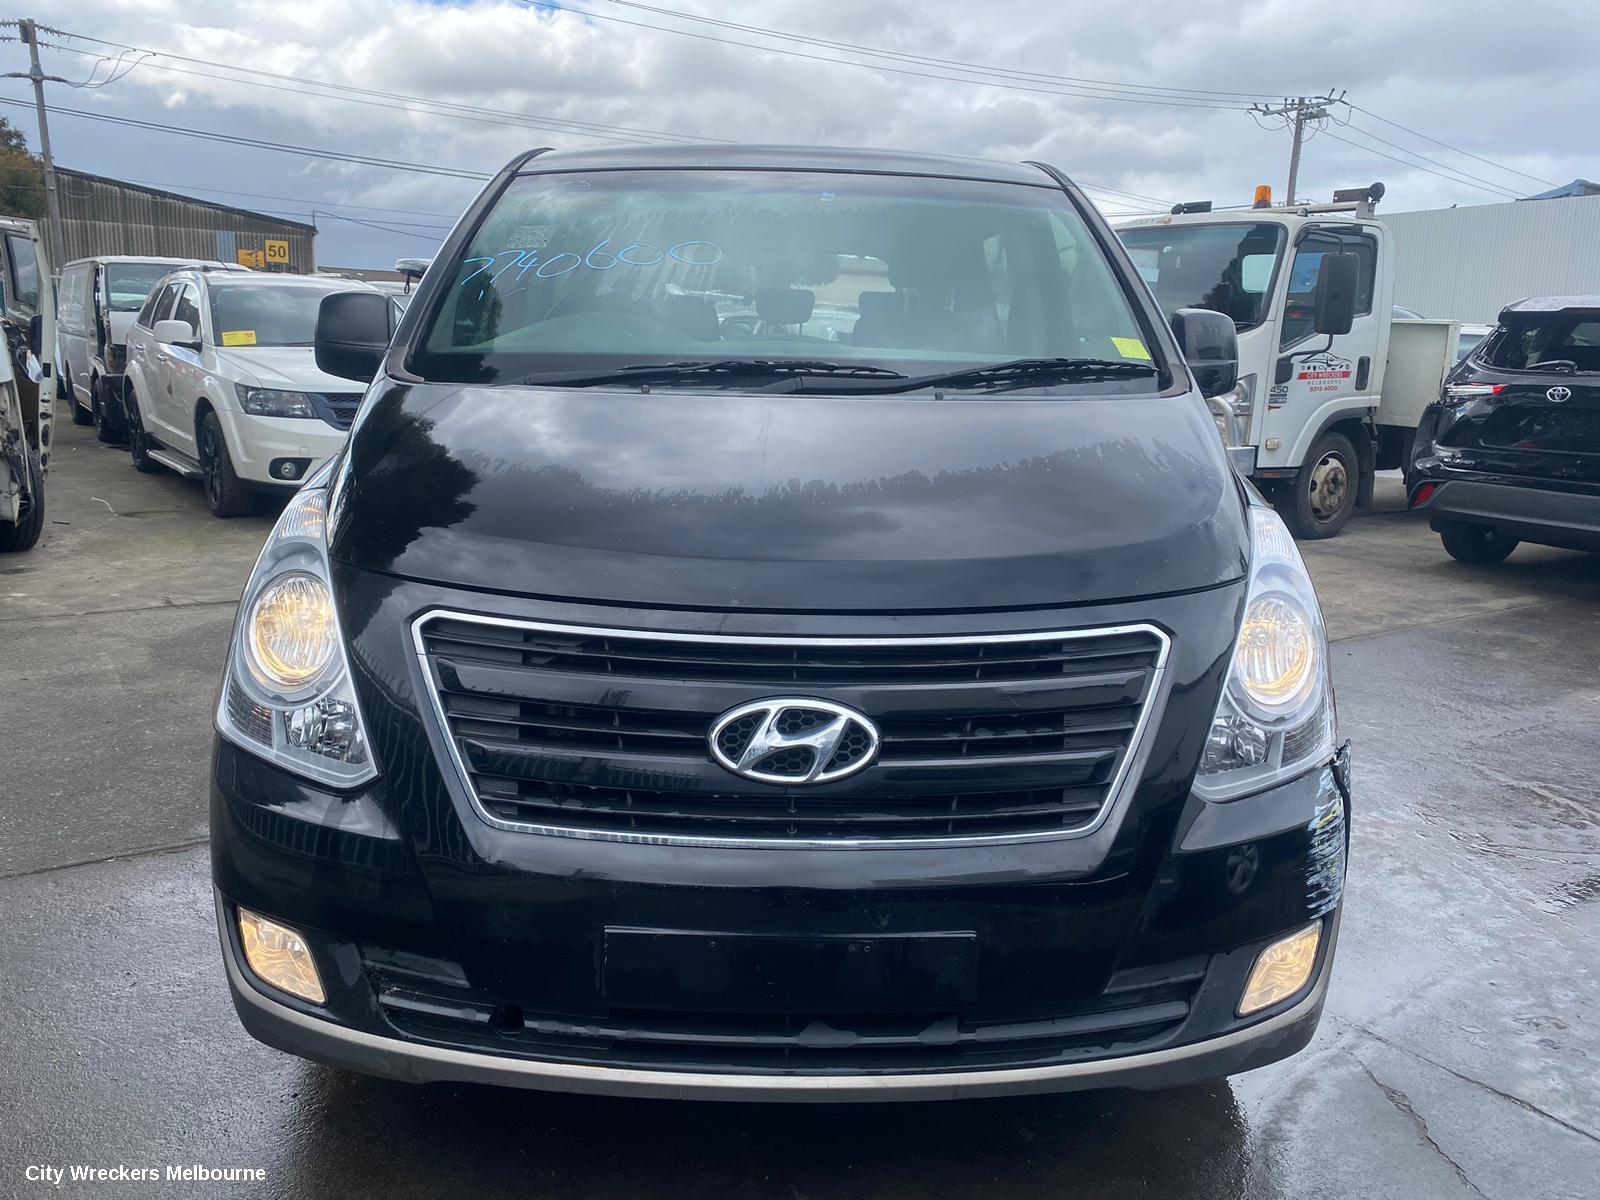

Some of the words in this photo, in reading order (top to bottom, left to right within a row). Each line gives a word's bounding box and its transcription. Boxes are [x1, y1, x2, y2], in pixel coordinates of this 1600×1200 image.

[268, 244, 286, 258] 50
[461, 240, 722, 286] 7740600
[1270, 386, 1288, 394] 450
